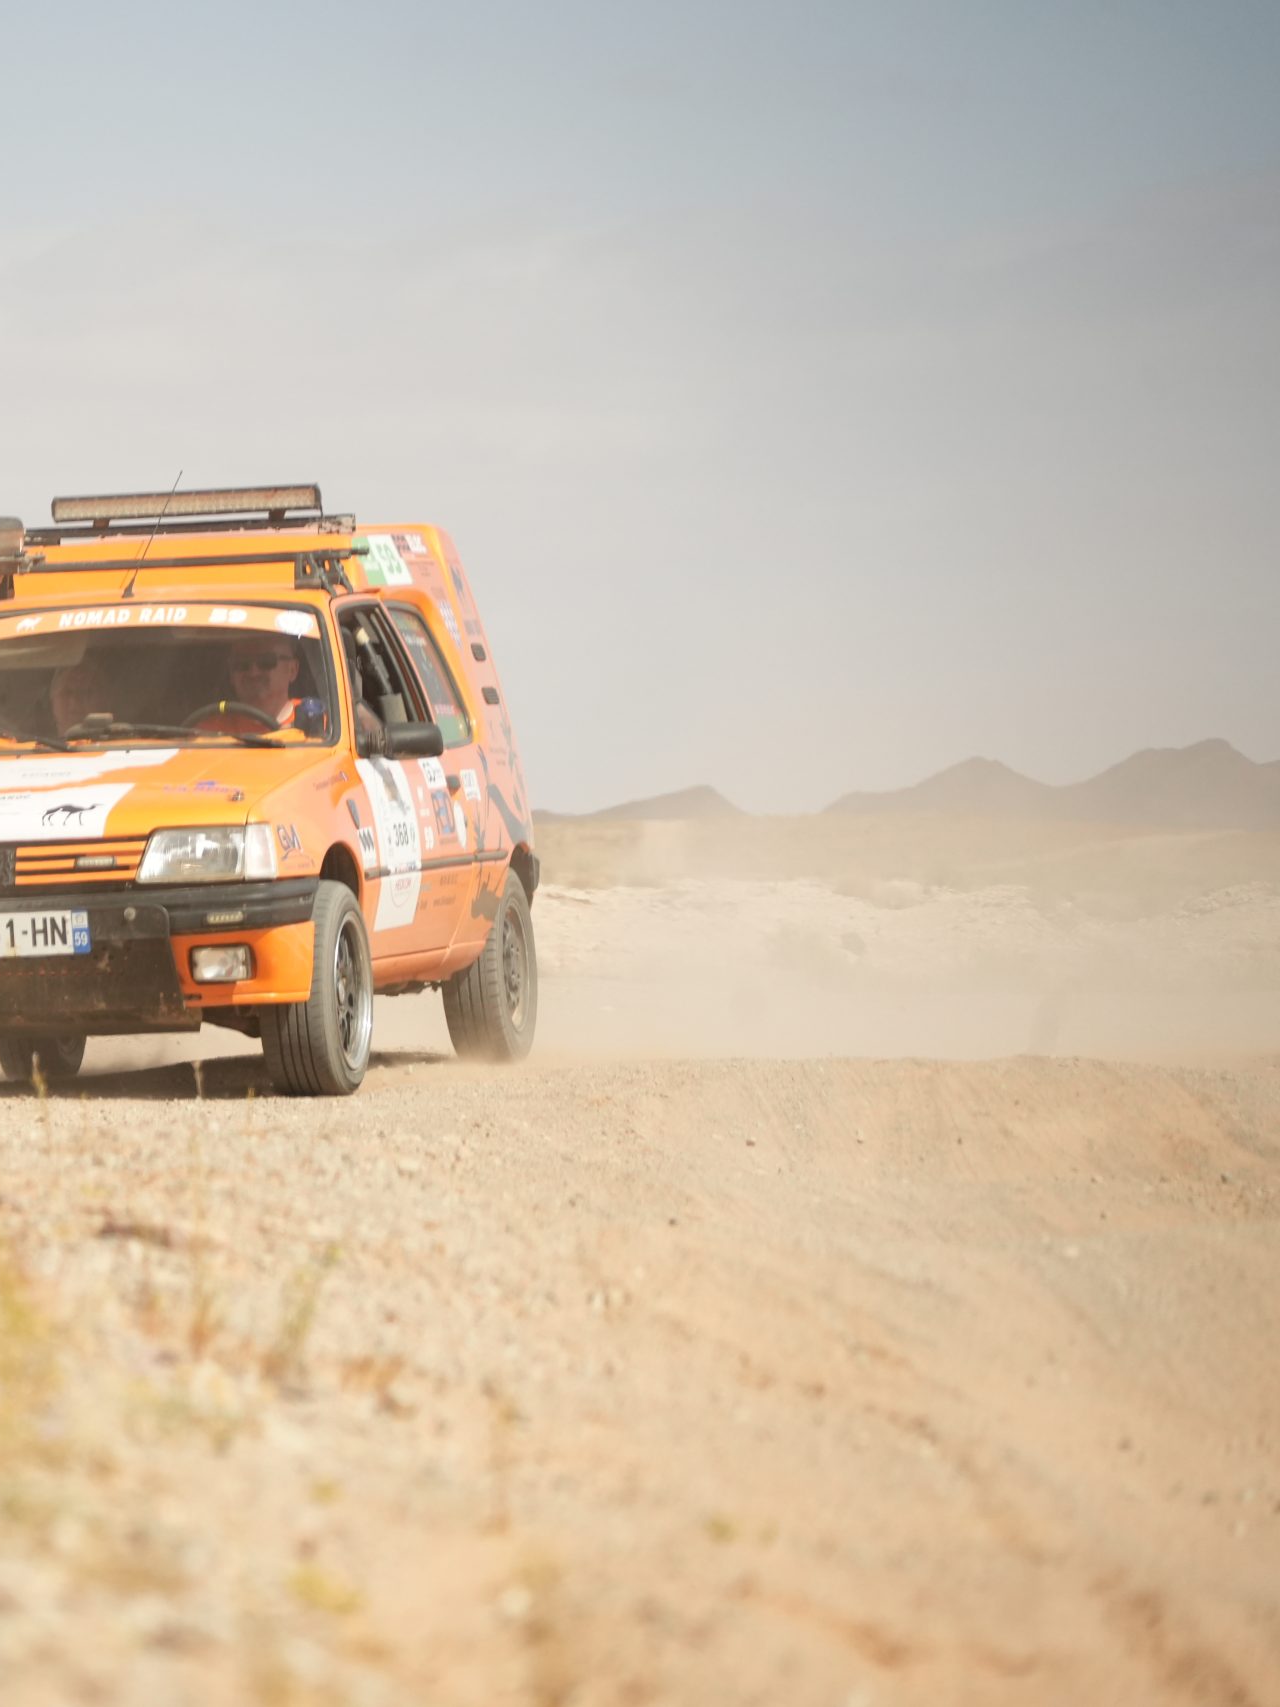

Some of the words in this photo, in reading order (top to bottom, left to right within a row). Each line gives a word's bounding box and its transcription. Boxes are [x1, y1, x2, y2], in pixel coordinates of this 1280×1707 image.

[58, 608, 131, 628] NOMAD
[138, 606, 188, 623] RAID
[392, 822, 410, 847] 368
[74, 931, 89, 946] 59
